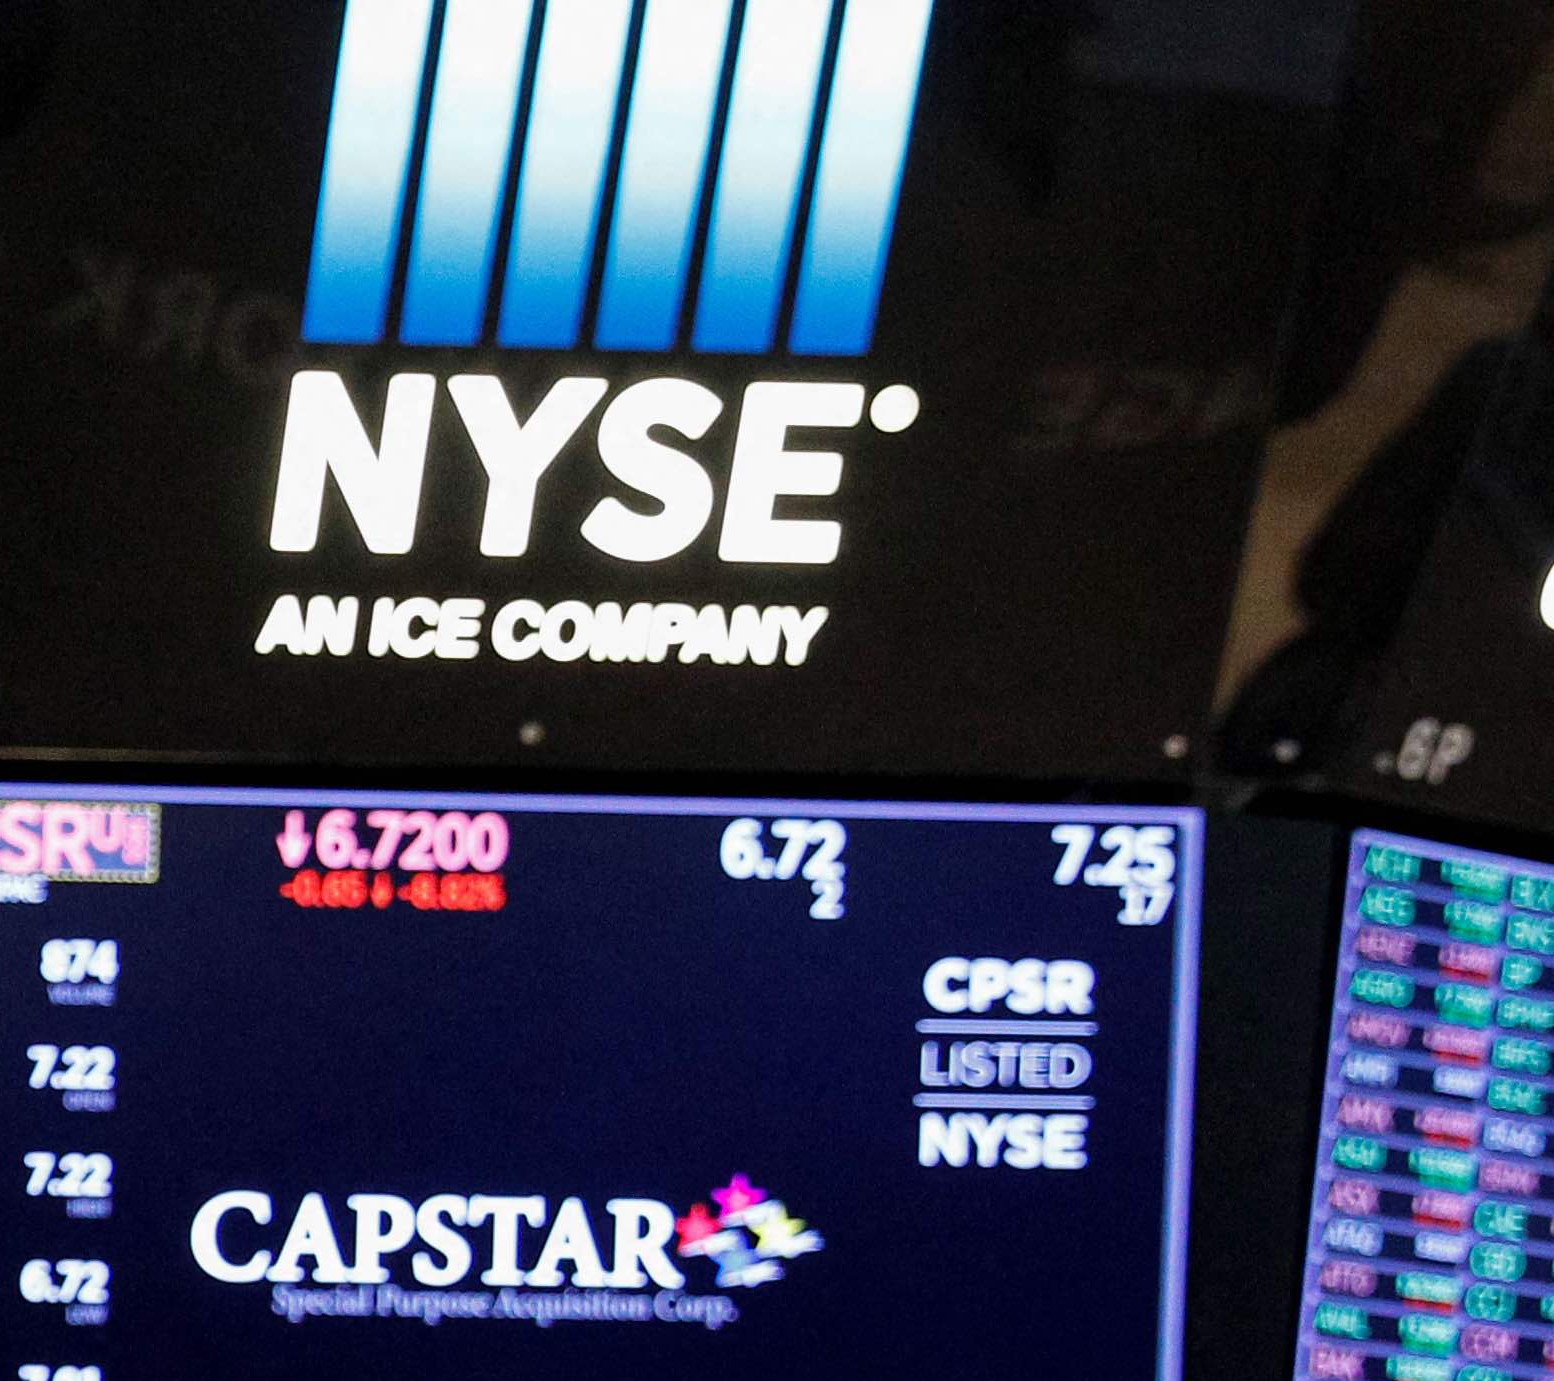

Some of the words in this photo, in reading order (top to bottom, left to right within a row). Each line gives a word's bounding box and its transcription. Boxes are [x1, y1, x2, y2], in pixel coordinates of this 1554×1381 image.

[269, 370, 866, 564] NYSE
[255, 594, 358, 656] AN
[369, 598, 485, 660] ICE
[491, 601, 829, 665] COMPANY
[315, 808, 509, 873] 6.7200
[720, 818, 847, 881] 6.72
[1051, 824, 1177, 886] 7.25
[40, 938, 121, 985] 874
[923, 957, 1097, 1015] CPSR
[26, 1044, 117, 1091] 7.22
[919, 1041, 1094, 1088] LISTED
[918, 1113, 1089, 1170] NYSE
[24, 1151, 114, 1197] 7.22
[190, 1189, 685, 1287] CAPSTAR
[19, 1259, 111, 1304] 6.72
[272, 1283, 374, 1324] Special
[376, 1285, 493, 1326] Purpose
